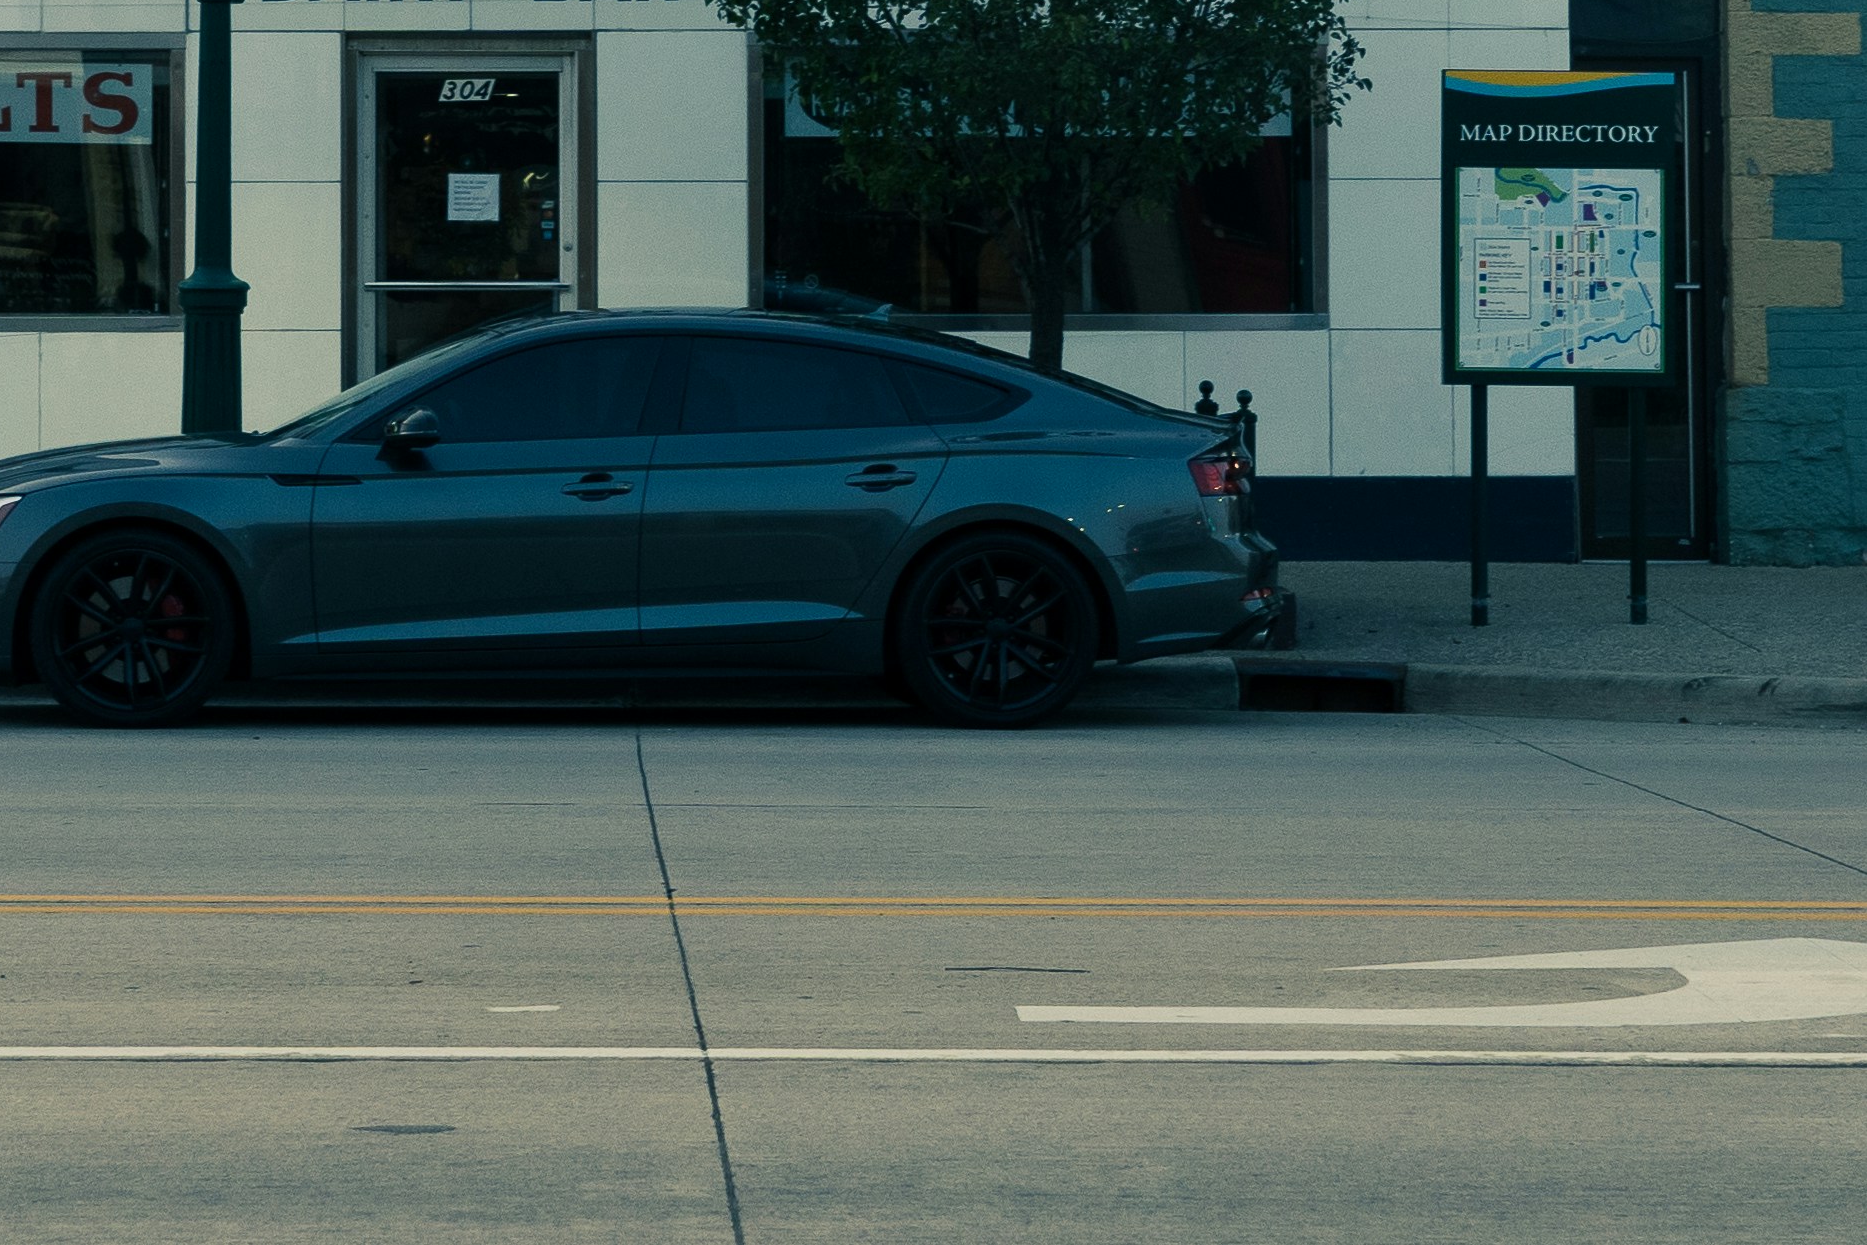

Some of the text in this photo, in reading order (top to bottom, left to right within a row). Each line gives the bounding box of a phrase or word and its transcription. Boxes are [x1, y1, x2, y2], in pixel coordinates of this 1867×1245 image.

[442, 80, 492, 100] 304
[1460, 124, 1659, 143] MAP DIRECTORY
